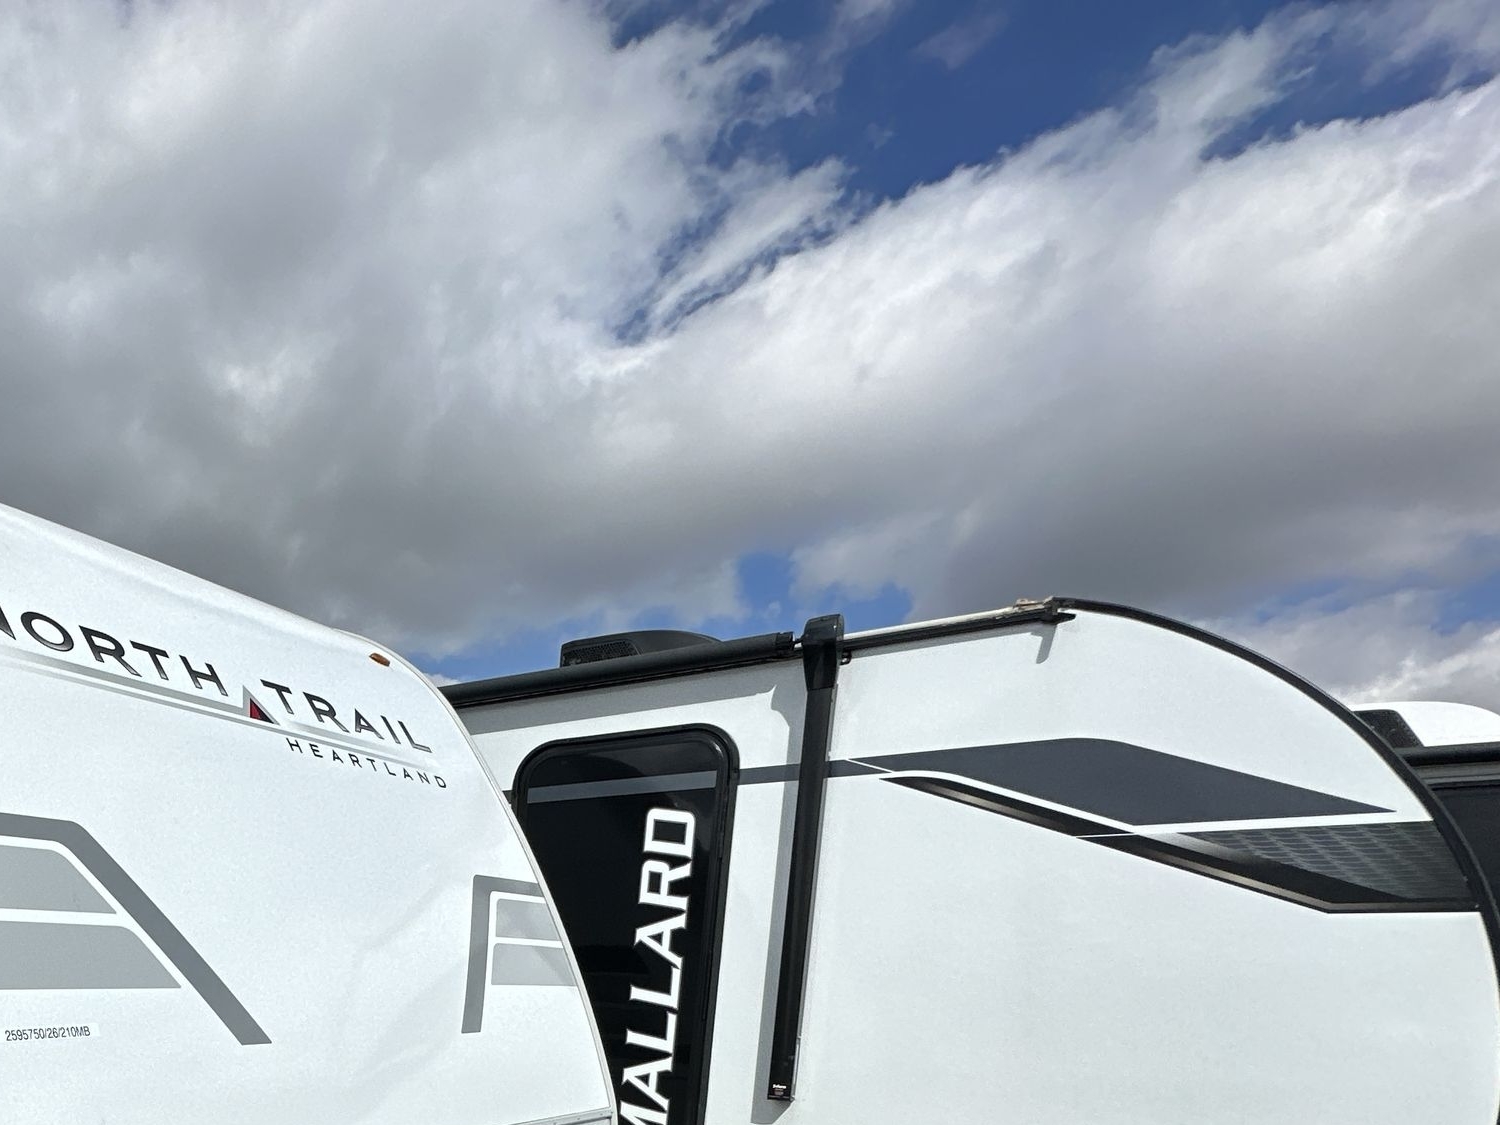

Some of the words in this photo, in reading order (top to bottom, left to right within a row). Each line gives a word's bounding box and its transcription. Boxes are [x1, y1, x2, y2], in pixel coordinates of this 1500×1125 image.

[260, 678, 433, 753] TRAIL
[286, 737, 447, 789] HEARTLAND
[5, 1025, 91, 1041] 2595750/26/210MB
